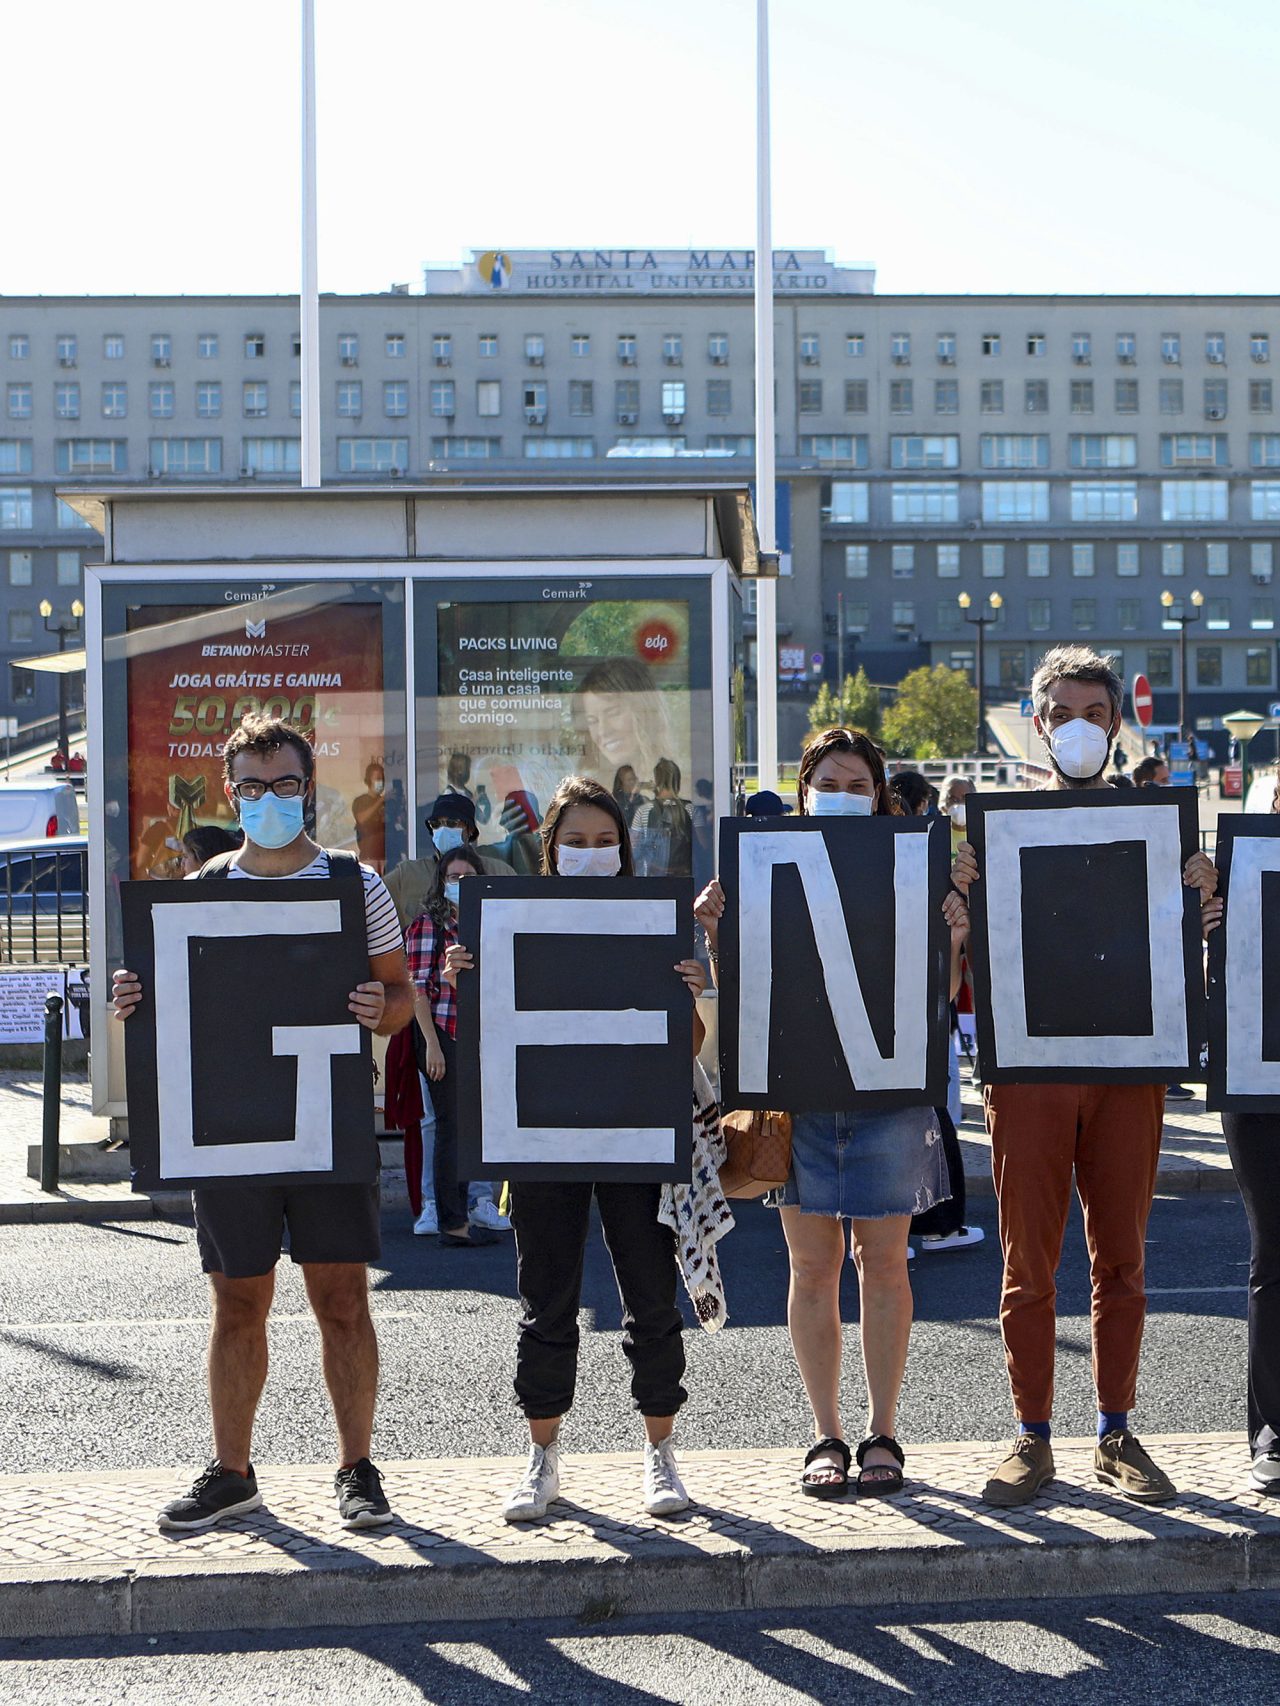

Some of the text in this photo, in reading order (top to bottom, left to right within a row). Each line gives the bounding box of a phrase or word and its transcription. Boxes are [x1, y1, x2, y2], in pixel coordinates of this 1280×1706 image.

[551, 251, 660, 270] SANTA
[526, 272, 828, 290] HOSPITAL UNIVERSIÁRIO
[224, 590, 269, 601] Cemark
[542, 587, 587, 599] Cemark
[459, 638, 558, 650] PACKS LIVING
[644, 636, 668, 652] edp
[169, 670, 342, 688] JOGA GRÁTIS E GANHA
[458, 668, 573, 684] Casa inteligente
[459, 683, 541, 696] é uma casa
[459, 696, 562, 711] que comunica
[459, 711, 518, 727] comigo.
